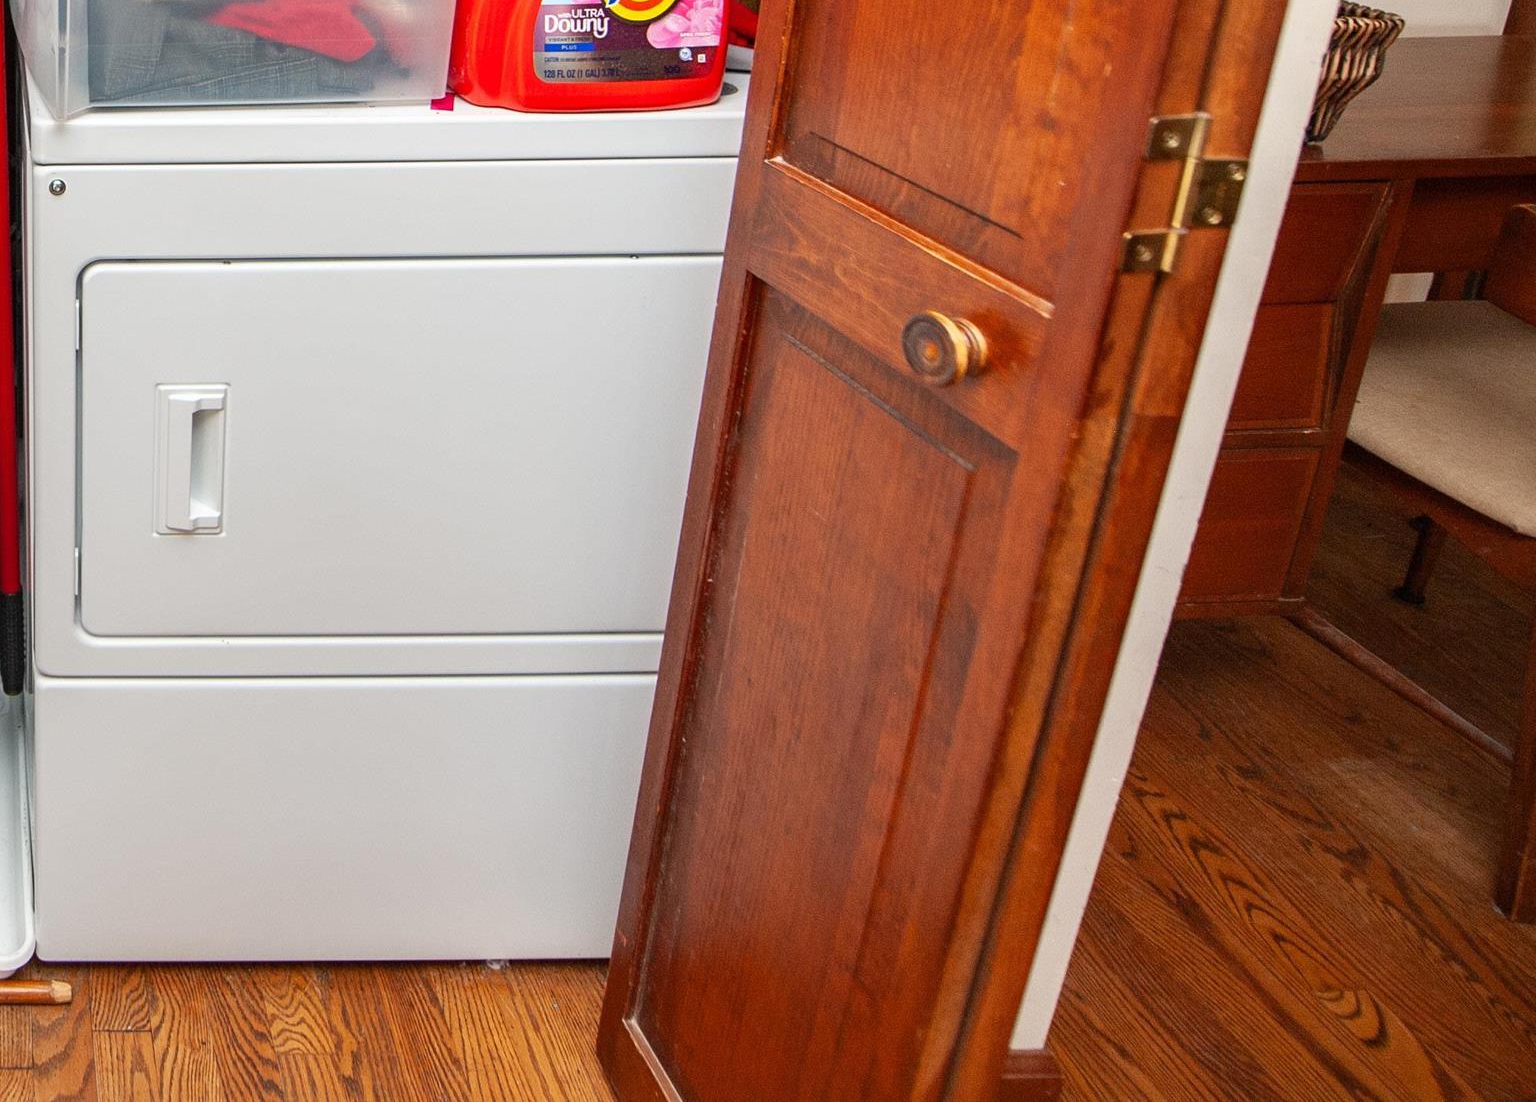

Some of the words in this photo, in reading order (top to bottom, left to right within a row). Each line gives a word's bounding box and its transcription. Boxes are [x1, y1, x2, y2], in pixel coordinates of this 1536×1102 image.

[571, 8, 606, 18] ULTRA
[544, 14, 610, 39] Downy
[544, 69, 556, 78] 128
[566, 69, 576, 78] OZ
